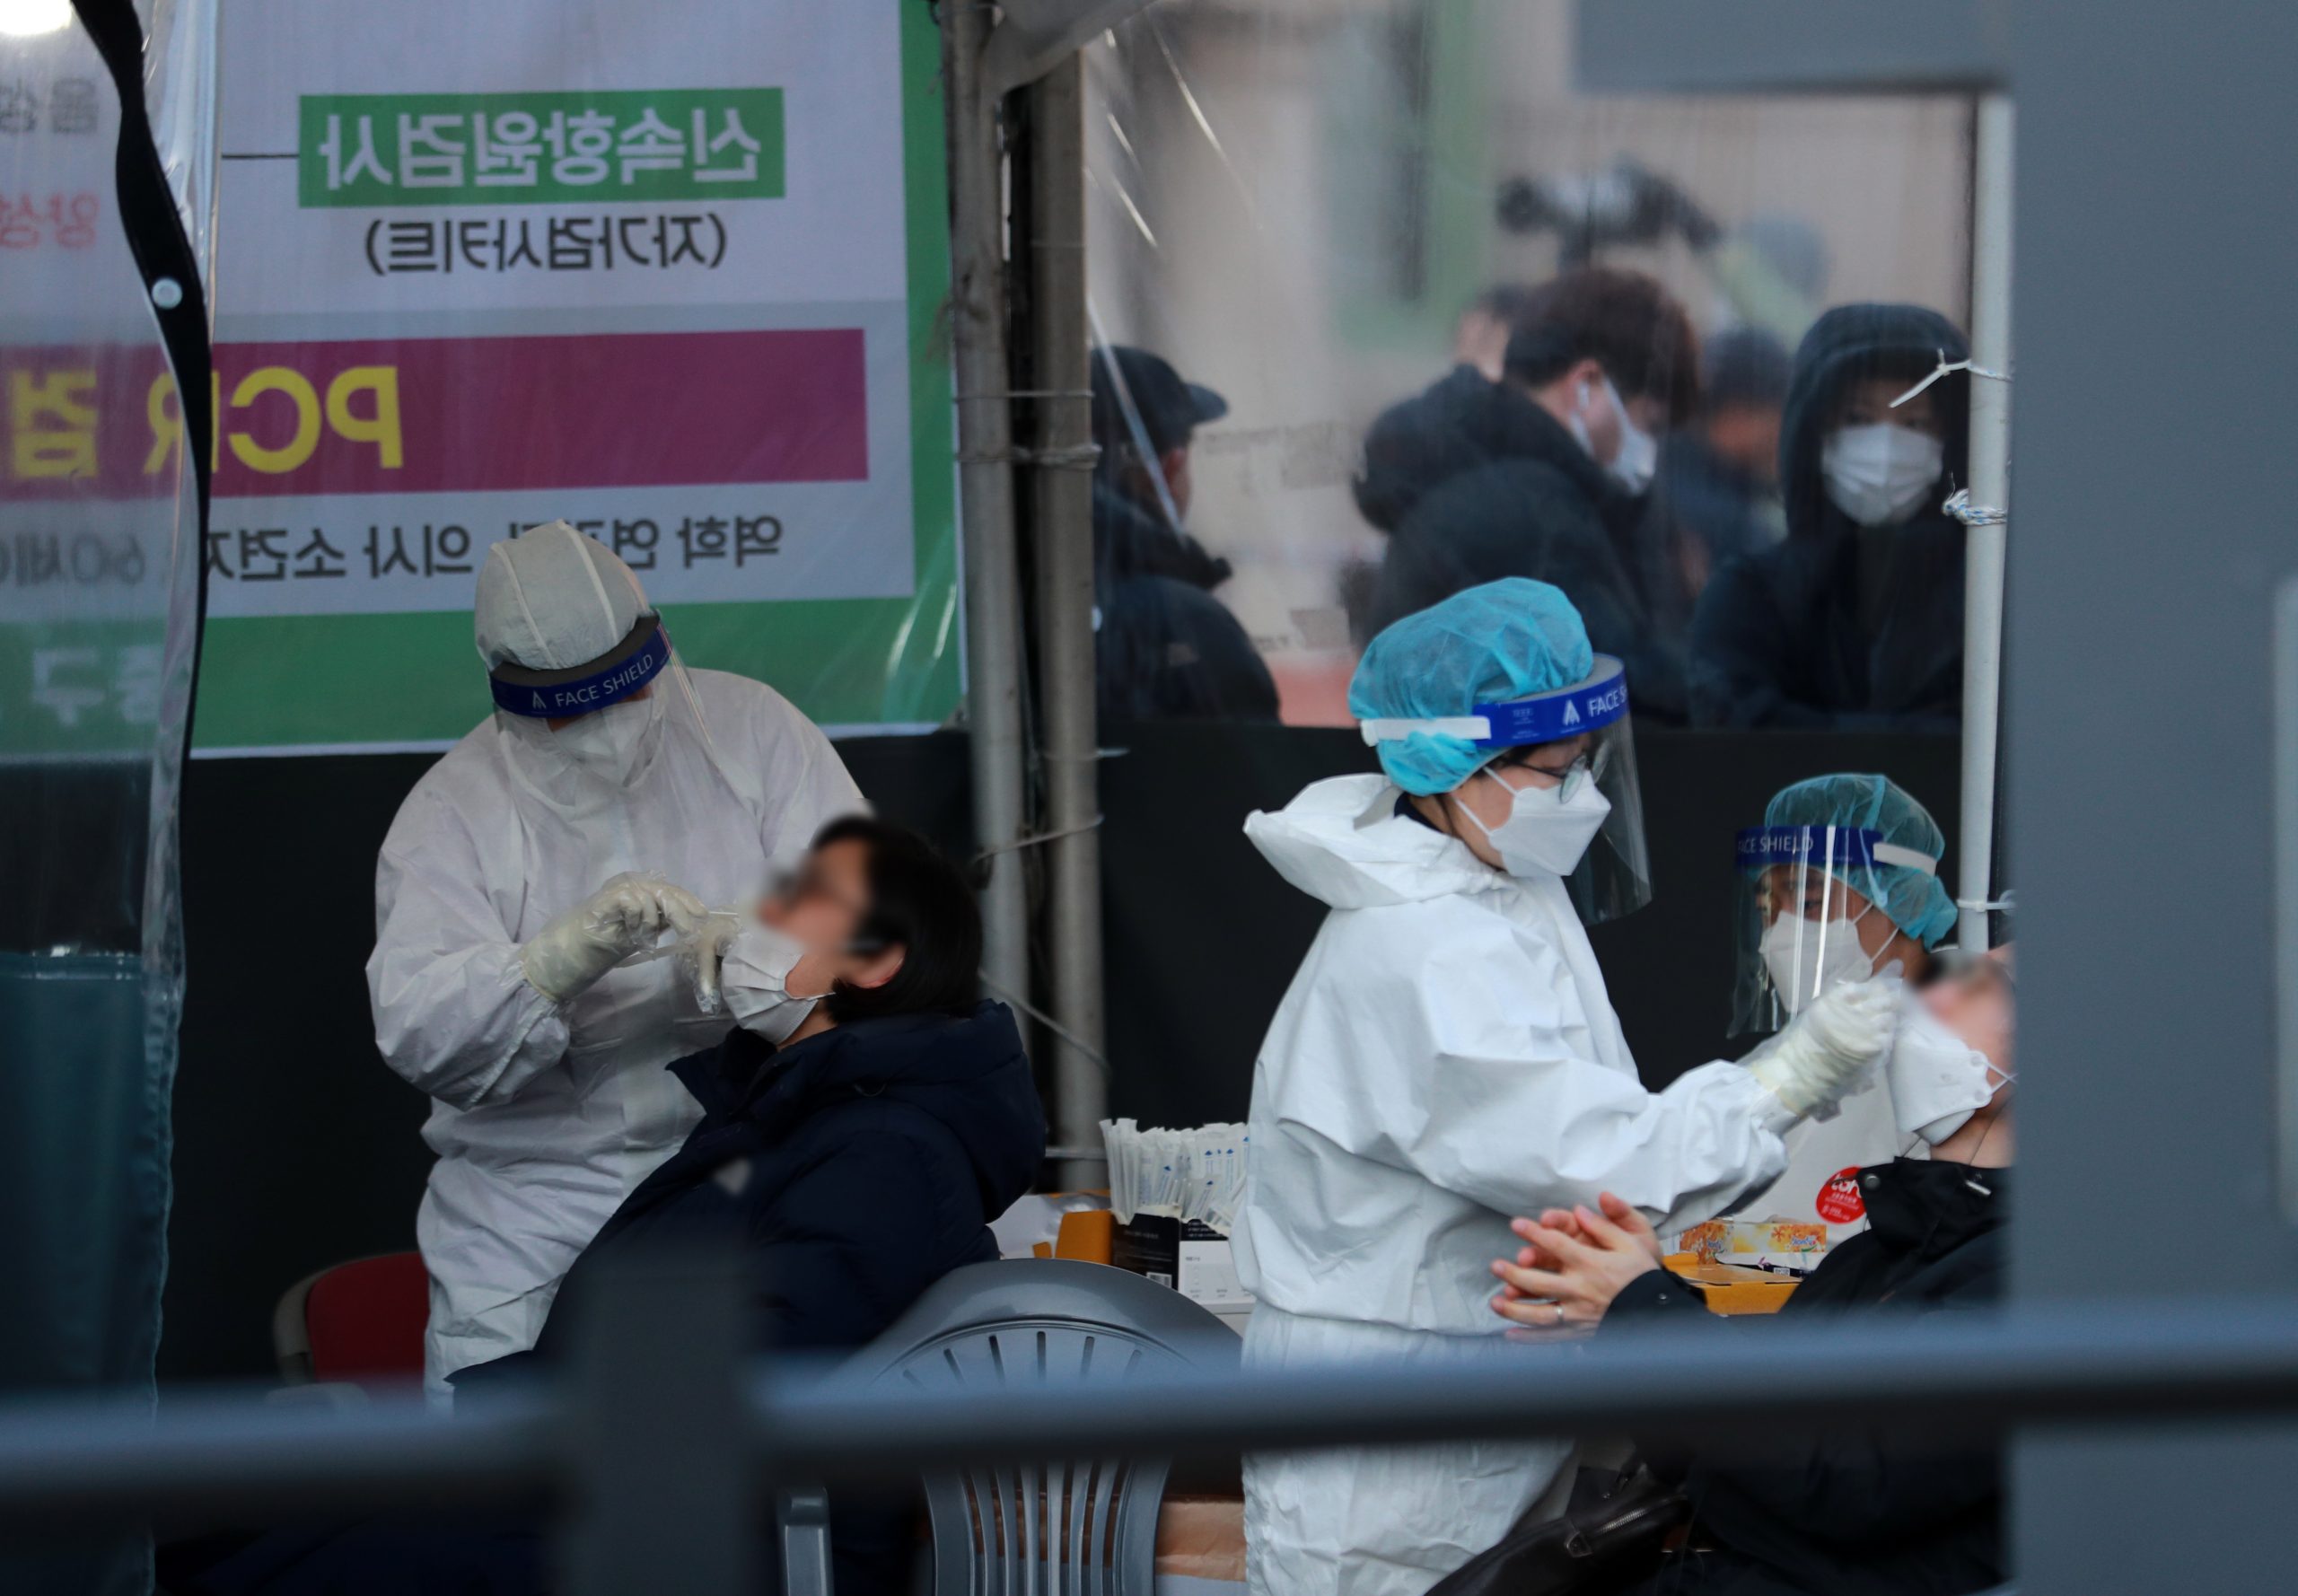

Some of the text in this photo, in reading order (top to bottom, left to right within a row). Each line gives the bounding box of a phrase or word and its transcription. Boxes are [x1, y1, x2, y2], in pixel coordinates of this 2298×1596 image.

[554, 653, 654, 708] FACE SHIELD
[1587, 689, 1619, 718] FACE
[1759, 834, 1814, 854] SHIELD
